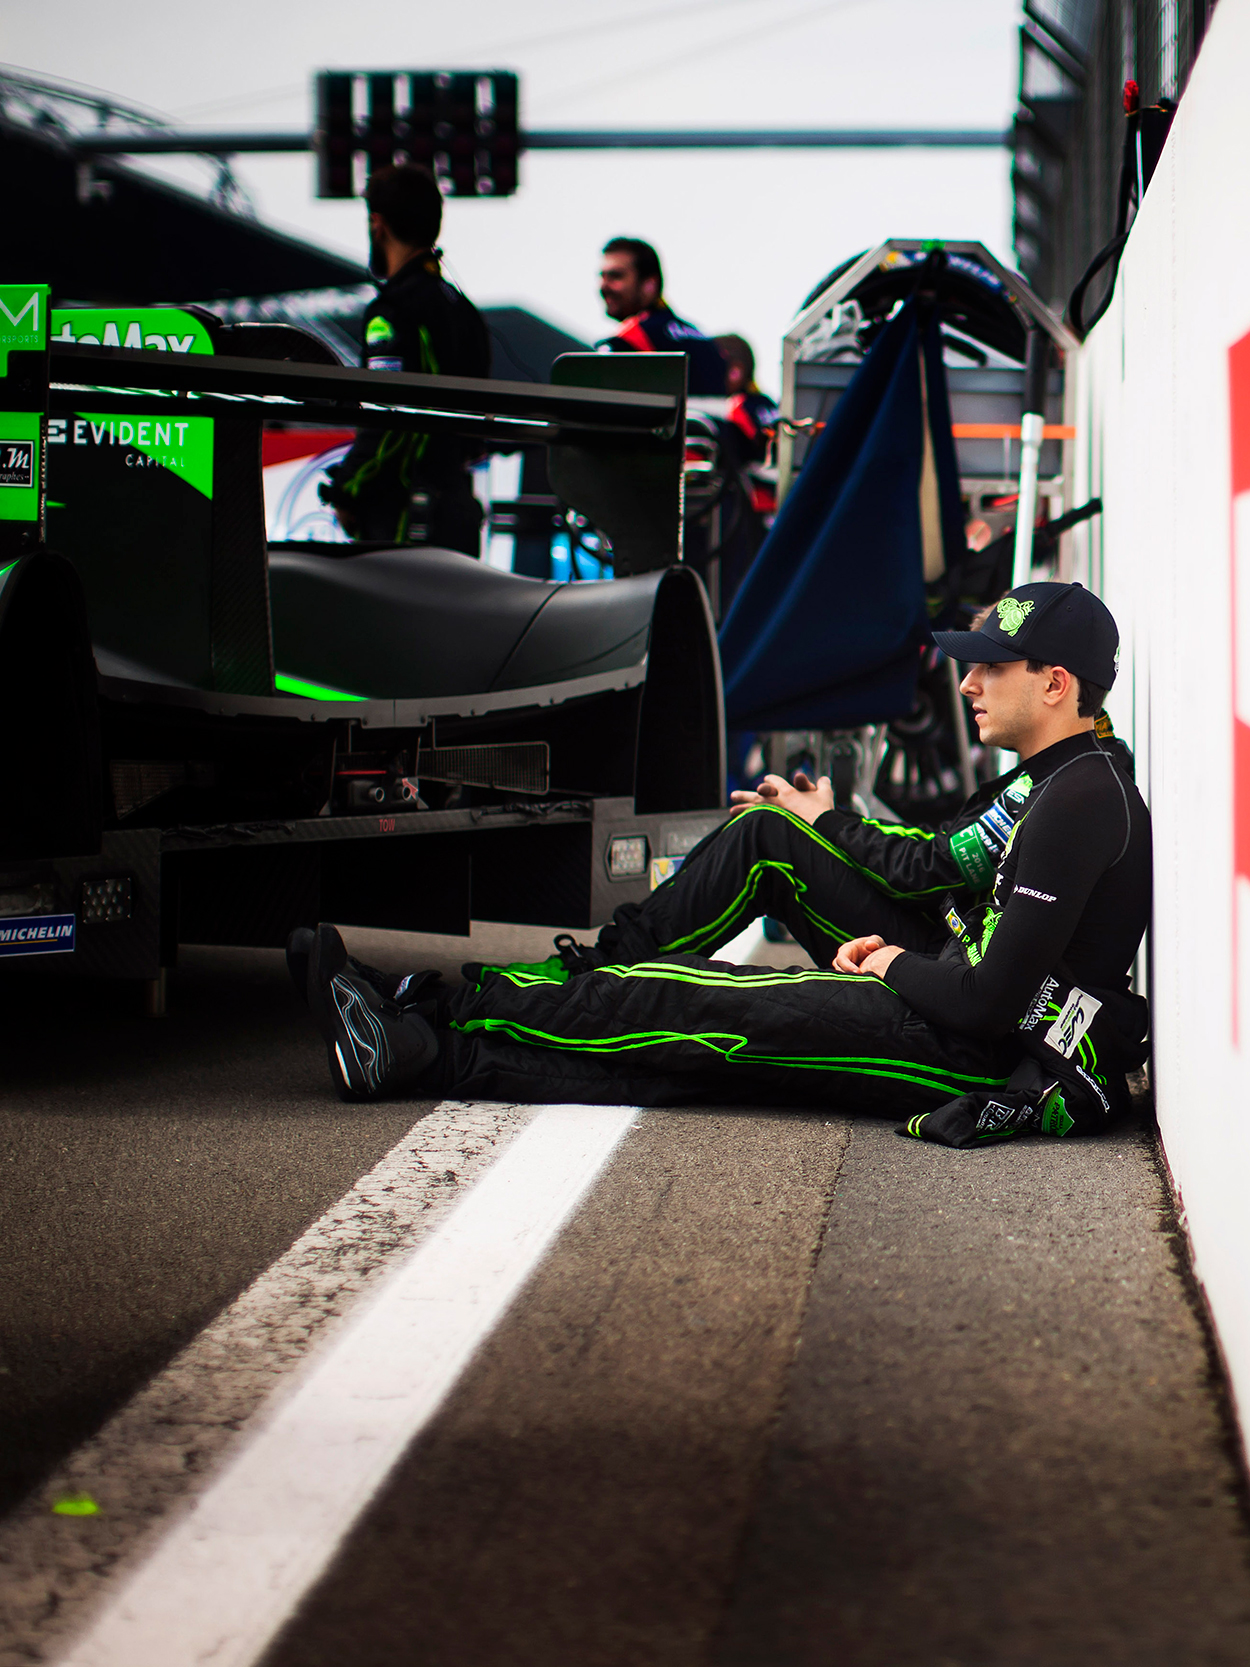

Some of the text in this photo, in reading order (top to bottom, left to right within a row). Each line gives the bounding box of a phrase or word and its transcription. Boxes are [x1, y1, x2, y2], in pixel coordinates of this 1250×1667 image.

[73, 420, 189, 446] EVIDENT
[124, 453, 185, 468] CAPITAL
[379, 818, 396, 832] TOW
[958, 846, 970, 861] PIT
[966, 862, 981, 884] LANE
[972, 852, 985, 873] 2016
[1017, 886, 1058, 902] DUNLOP
[0, 925, 73, 941] MICHELIN
[1024, 977, 1060, 1031] AutoMax
